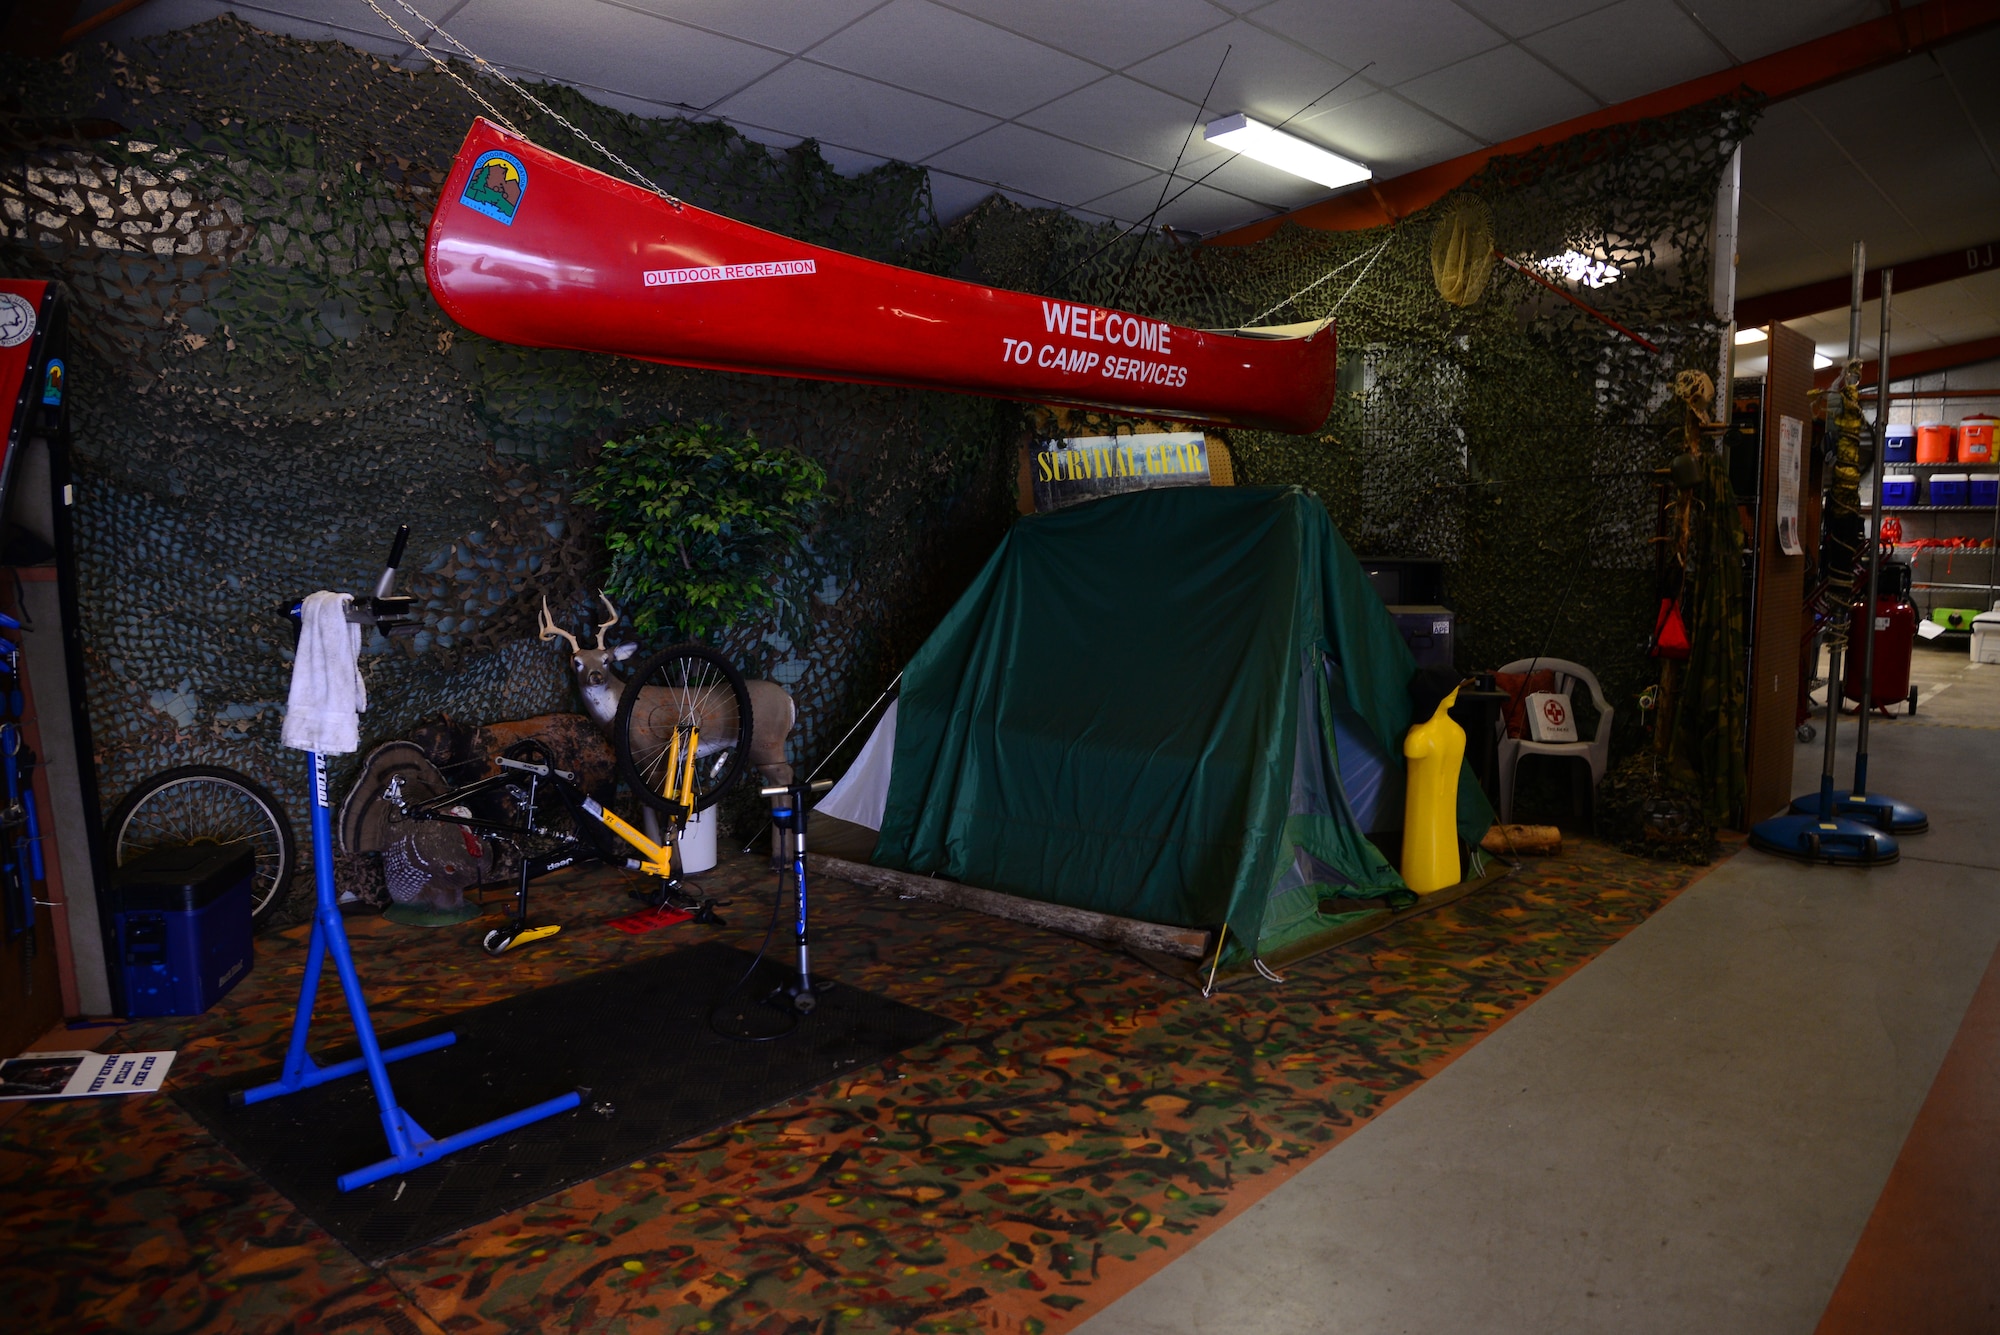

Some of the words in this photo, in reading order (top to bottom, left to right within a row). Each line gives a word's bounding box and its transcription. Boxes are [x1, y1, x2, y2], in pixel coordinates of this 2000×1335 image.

[476, 151, 503, 166] OUTDOOR
[505, 152, 526, 187] RECREATION
[646, 268, 721, 285] OUTDOOR
[725, 261, 813, 279] RECREATION
[1042, 301, 1171, 354] WELCOME
[1003, 338, 1032, 364] TO
[1038, 344, 1099, 374] CAMP
[1102, 355, 1187, 387] SERVICES
[1037, 447, 1142, 482] SURVIVAL
[1146, 443, 1203, 474] GEAR
[546, 857, 573, 871] Jeep
[98, 1054, 120, 1076] REPAIR
[112, 1061, 136, 1084] BICYCLE
[87, 1076, 107, 1092] AREA
